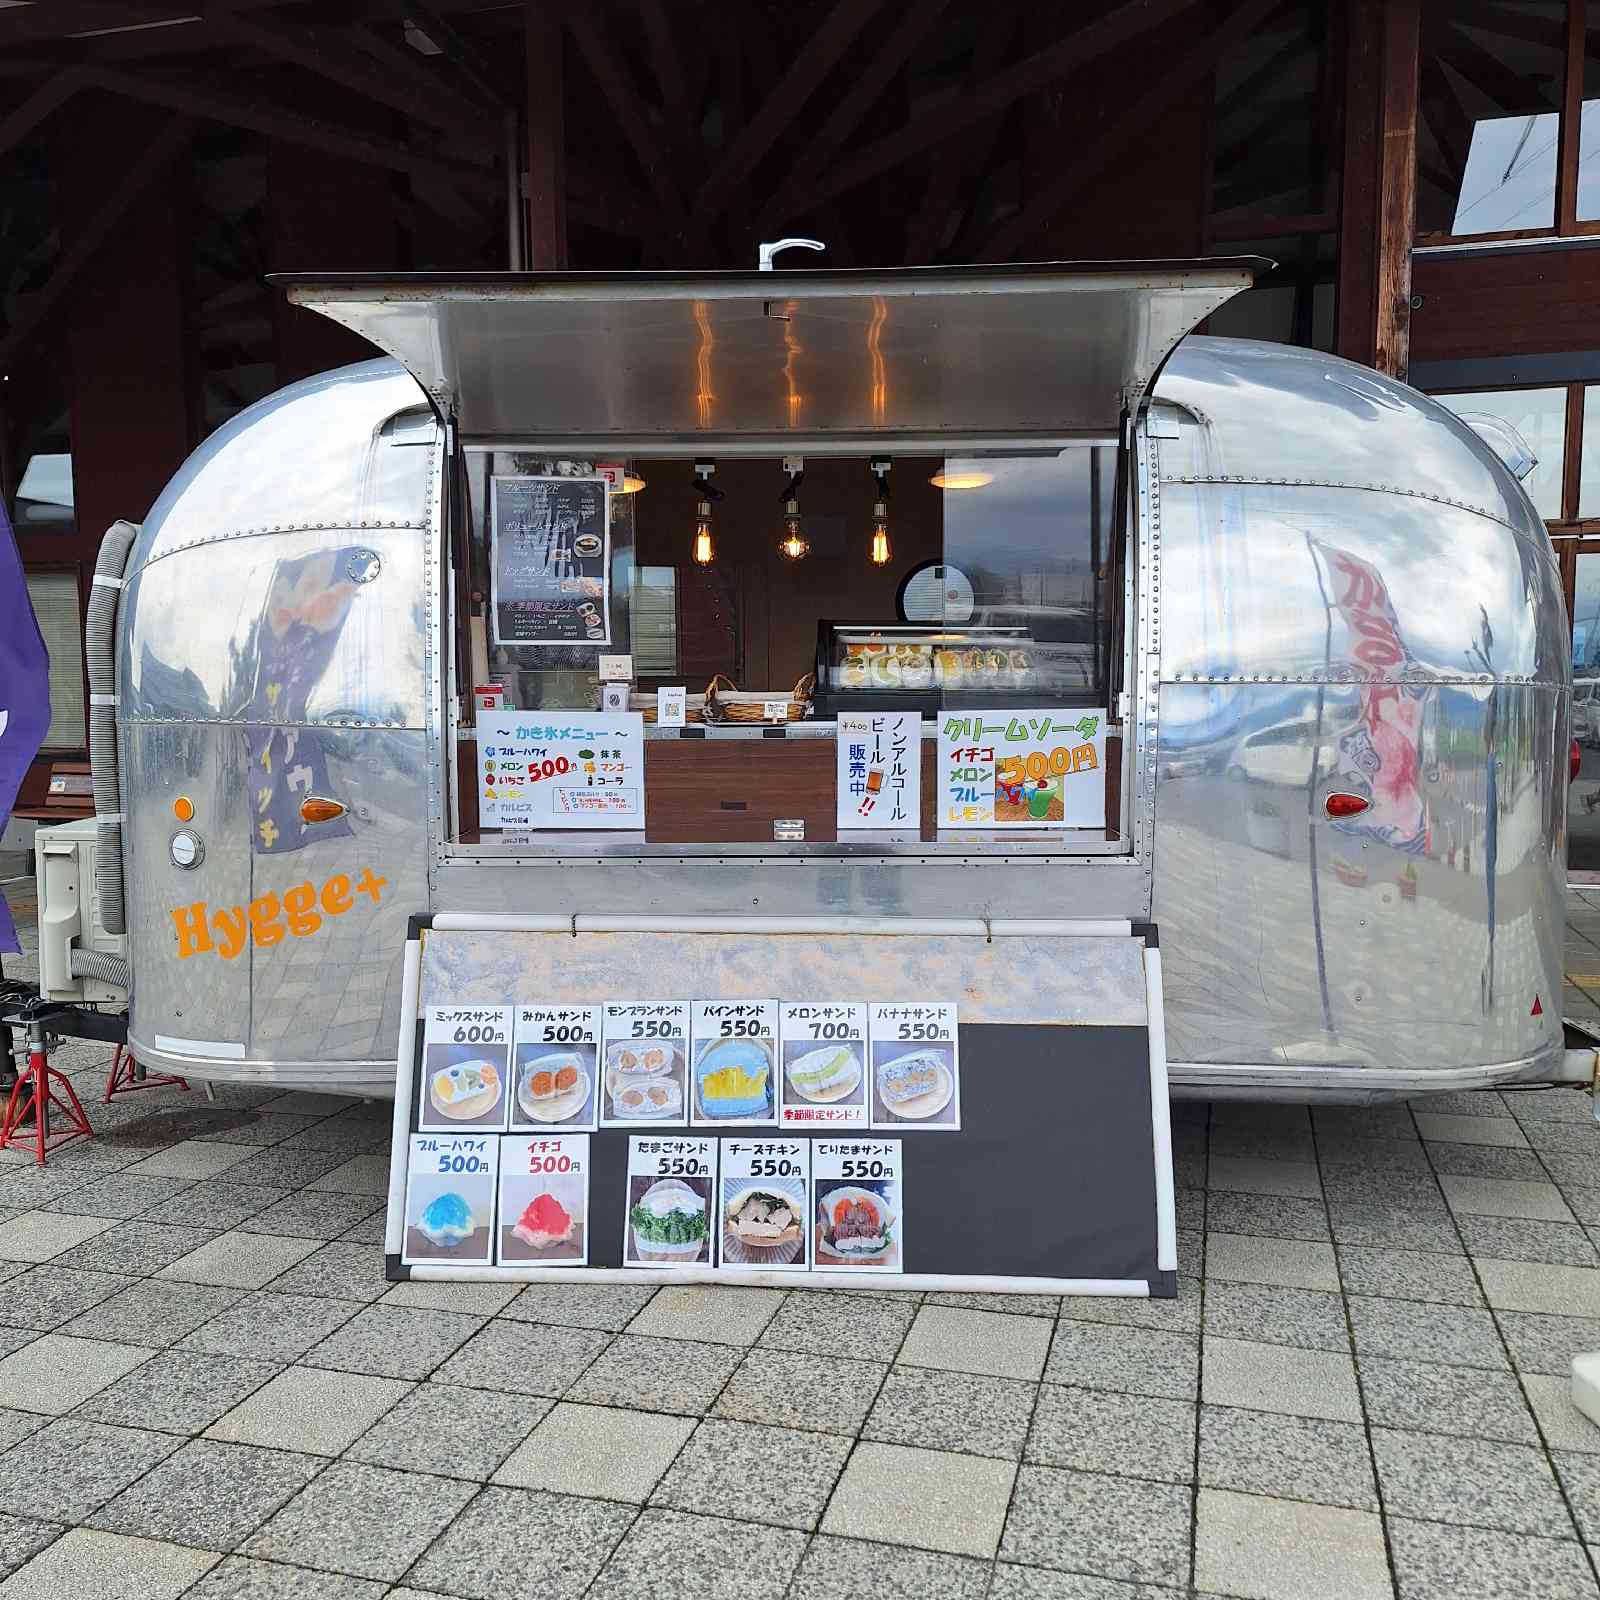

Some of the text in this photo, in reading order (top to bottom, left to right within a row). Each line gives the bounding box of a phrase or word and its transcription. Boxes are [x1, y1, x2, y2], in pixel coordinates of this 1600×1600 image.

[943, 717, 1099, 742] クリームソーダ
[870, 717, 886, 764] ビール
[499, 747, 547, 757] ブルーハワイ
[600, 750, 621, 759] 抹茶
[950, 747, 994, 762] イチゴ
[500, 762, 523, 771] メロン
[600, 763, 632, 772] マンゴー
[890, 717, 907, 820] ノンアルコール
[999, 743, 1098, 786] 500円
[499, 776, 525, 785] いちご
[597, 776, 624, 786] コーラ
[950, 767, 992, 782] メロン
[949, 806, 993, 822] レモン
[171, 867, 388, 960] Hygge+
[435, 1011, 503, 1022] ミックスサンド
[522, 1011, 592, 1022] みかんサンド
[607, 1006, 682, 1016] モンブランサンド
[704, 1005, 764, 1016] パインサンド
[787, 1008, 856, 1019] メロンサンド
[877, 1008, 947, 1019] バナナサンド
[453, 1026, 504, 1042] 600円
[543, 1026, 593, 1042] 500円
[631, 1020, 682, 1037] 550円
[720, 1020, 770, 1037] 550円
[808, 1023, 859, 1039] 700円
[898, 1023, 949, 1039] 550円
[416, 1140, 487, 1151] ブルーハワイ
[527, 1141, 562, 1153] イチゴ
[638, 1142, 708, 1154] たまごサンド
[729, 1144, 800, 1155] チーズチキン
[818, 1145, 893, 1155] てりたまサンド
[438, 1155, 489, 1173] 500円
[529, 1156, 581, 1173] 500円
[658, 1158, 709, 1175] 550円
[750, 1160, 801, 1176] 550円
[841, 1161, 893, 1177] 550円
